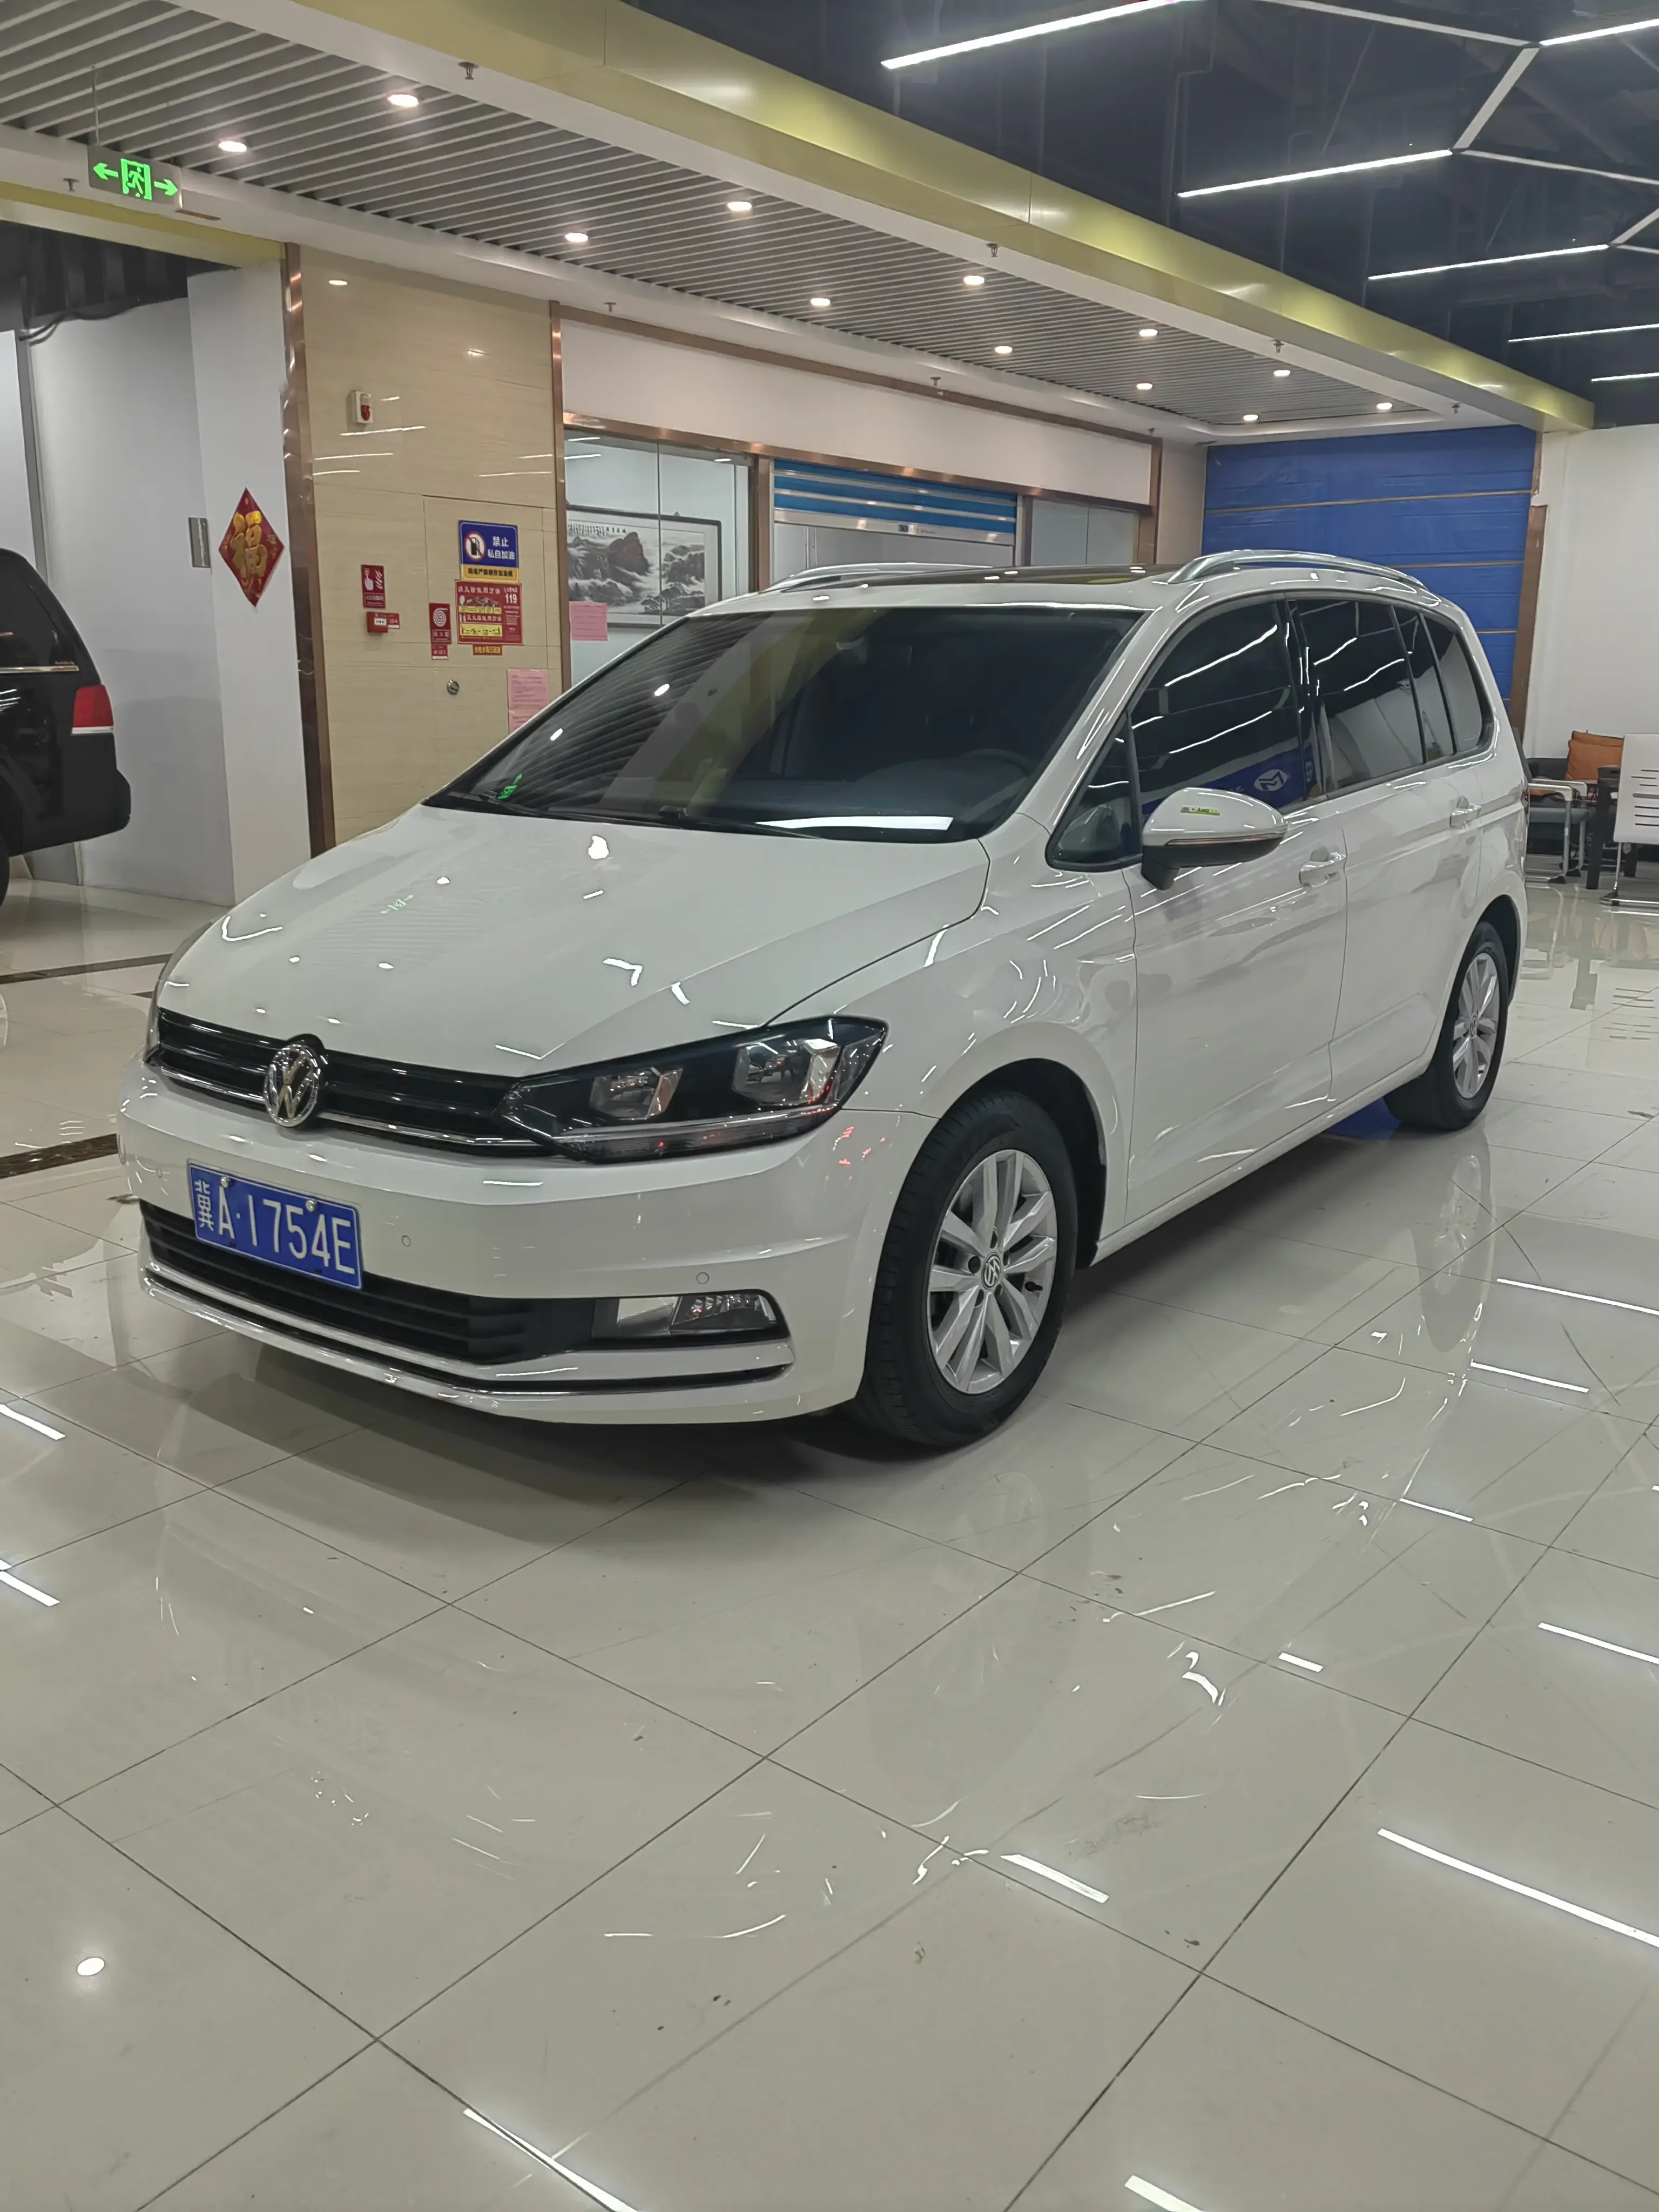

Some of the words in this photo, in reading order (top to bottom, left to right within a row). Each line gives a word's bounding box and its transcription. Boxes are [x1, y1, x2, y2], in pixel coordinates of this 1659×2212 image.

[492, 535, 509, 547] 禁止
[487, 549, 515, 560] 私自加油
[505, 593, 517, 604] 119
